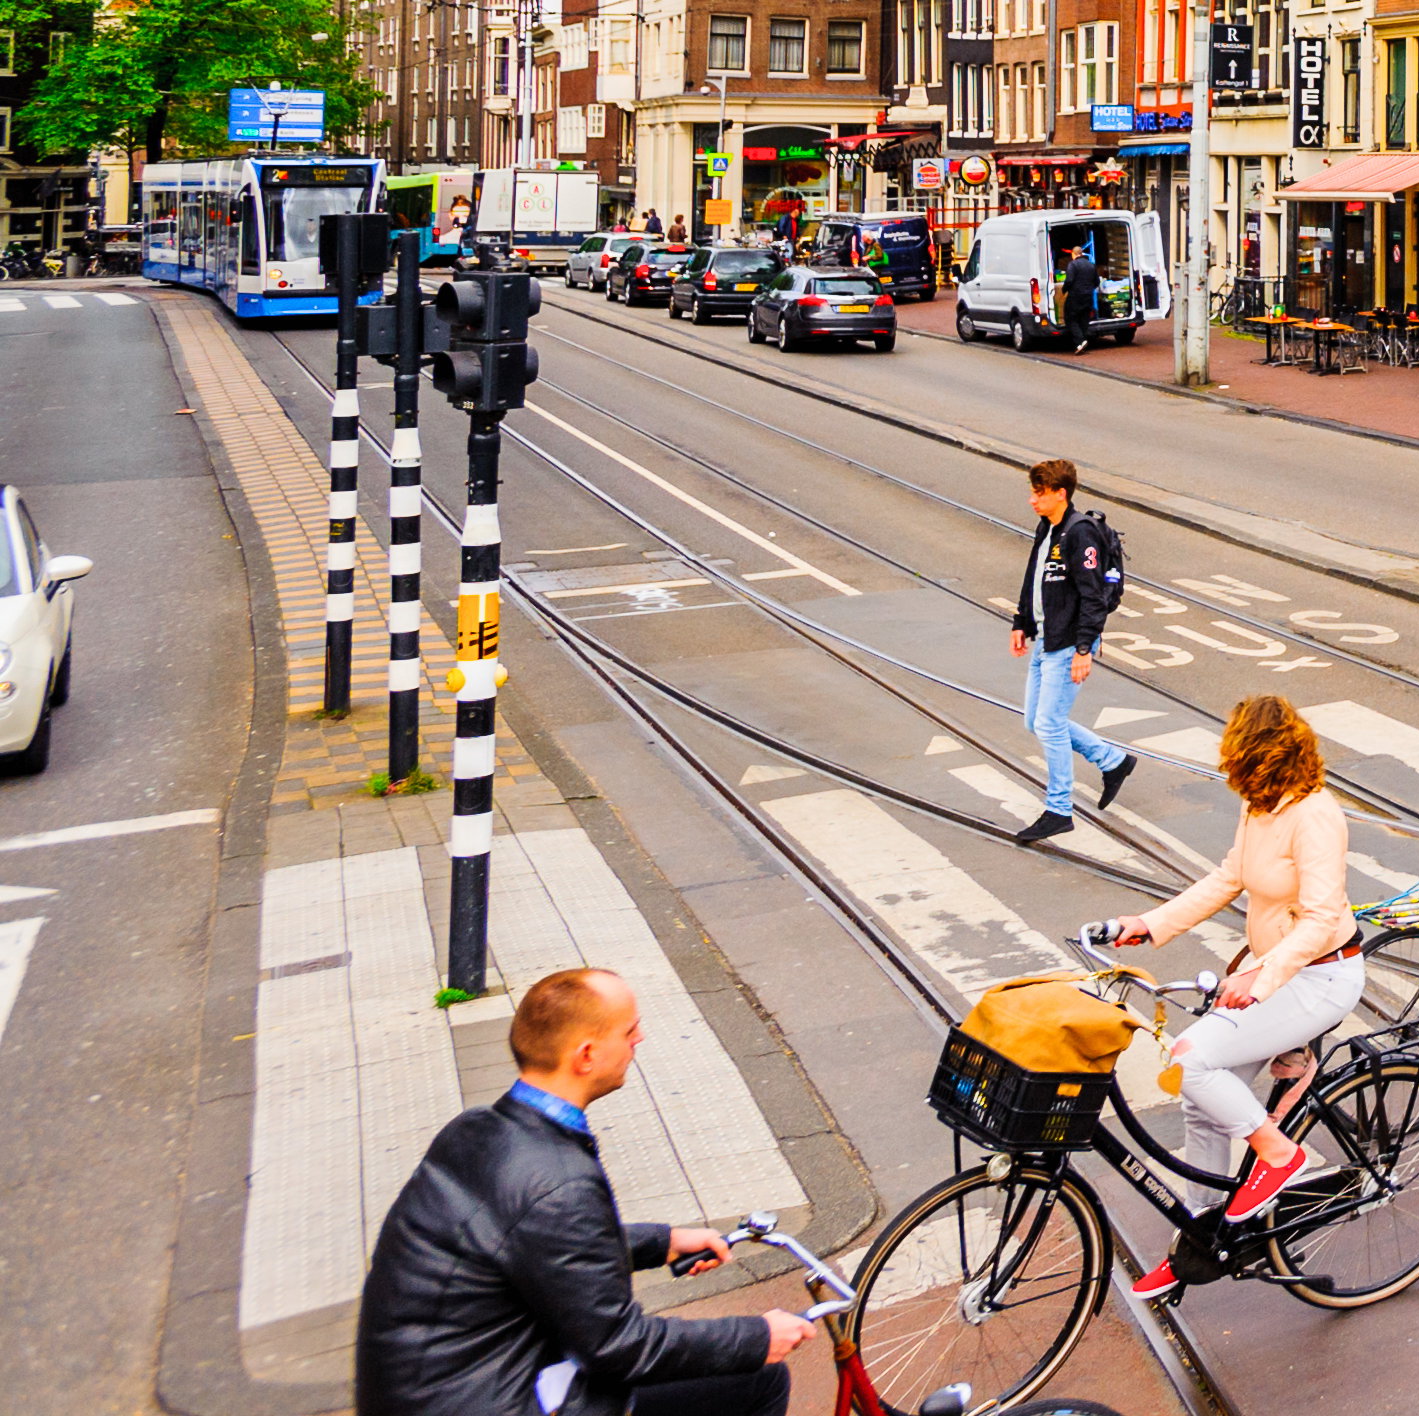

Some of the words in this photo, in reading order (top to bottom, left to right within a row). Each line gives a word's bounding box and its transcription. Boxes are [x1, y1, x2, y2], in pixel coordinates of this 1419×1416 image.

[1227, 28, 1239, 42] R
[1300, 41, 1322, 121] HOTEL
[1094, 107, 1132, 117] HOTEL
[1135, 112, 1158, 131] HOTEL
[272, 169, 280, 183] 2
[1083, 546, 1098, 569] 3
[1098, 610, 1400, 670] BUS
